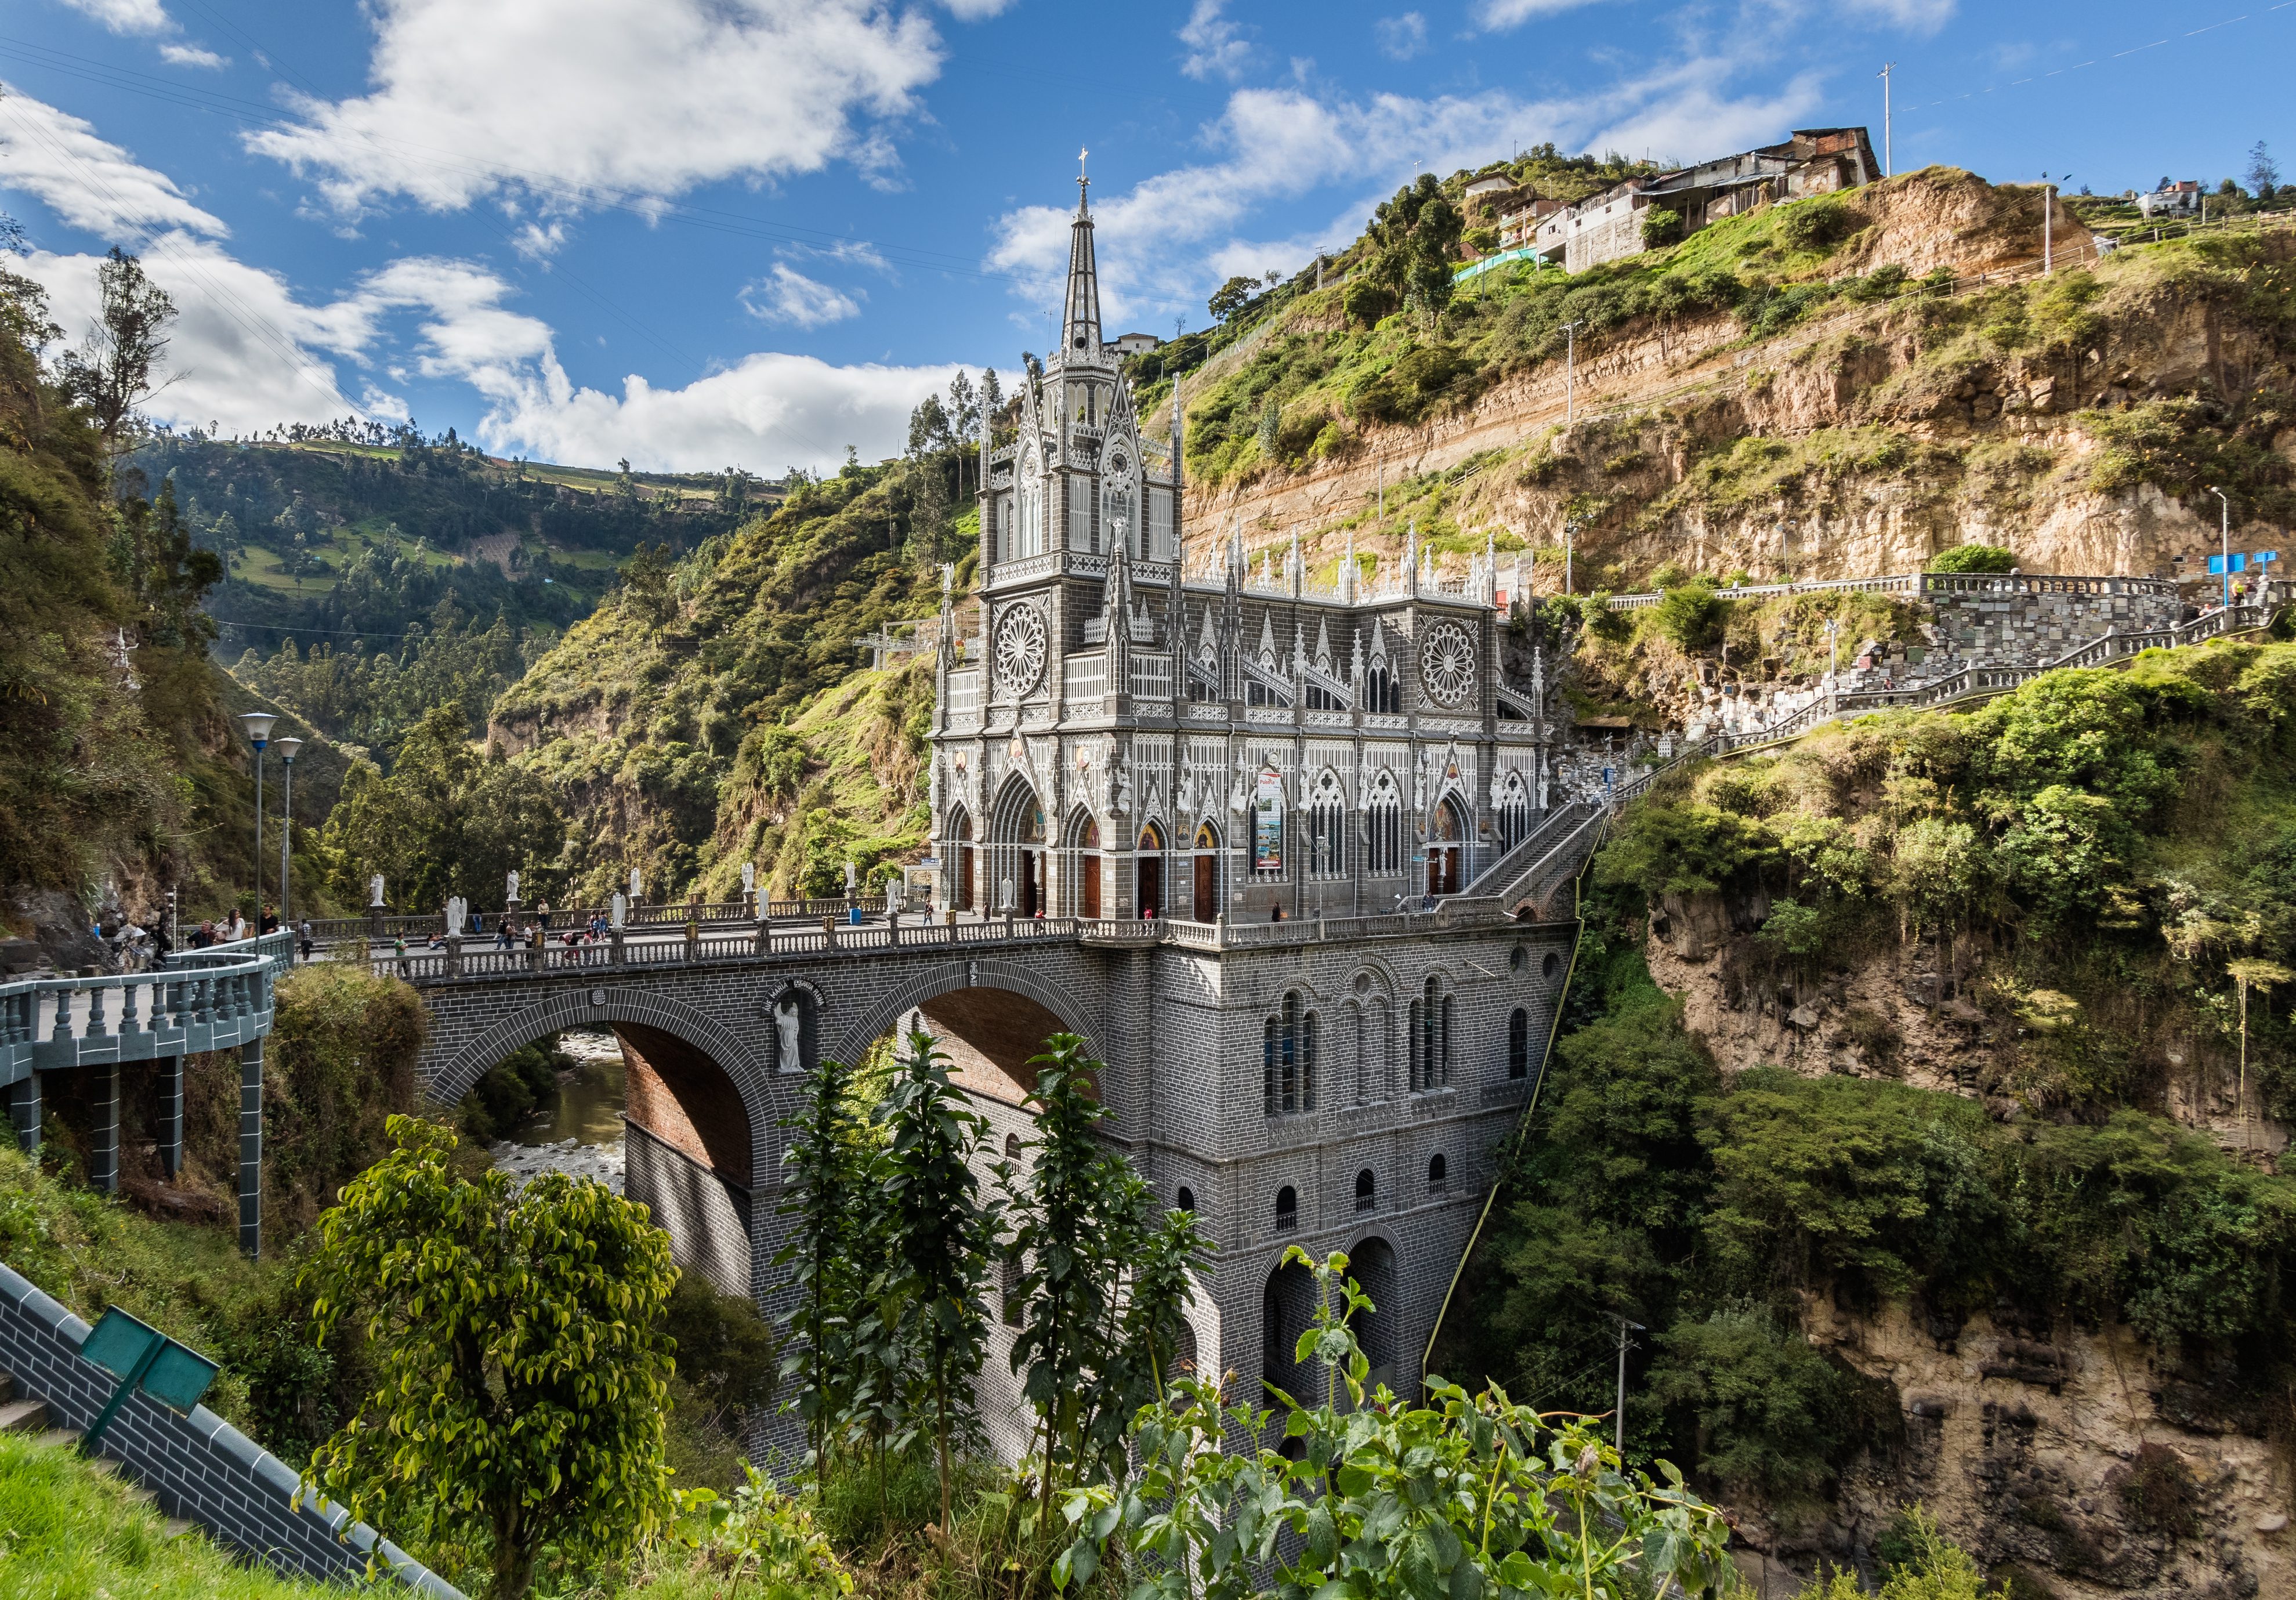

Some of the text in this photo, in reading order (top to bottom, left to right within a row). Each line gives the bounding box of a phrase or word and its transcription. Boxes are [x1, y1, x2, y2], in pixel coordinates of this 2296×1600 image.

[765, 1000, 773, 1012] AVE
[770, 982, 788, 998] MARIA
[813, 989, 824, 1006] PLENA
